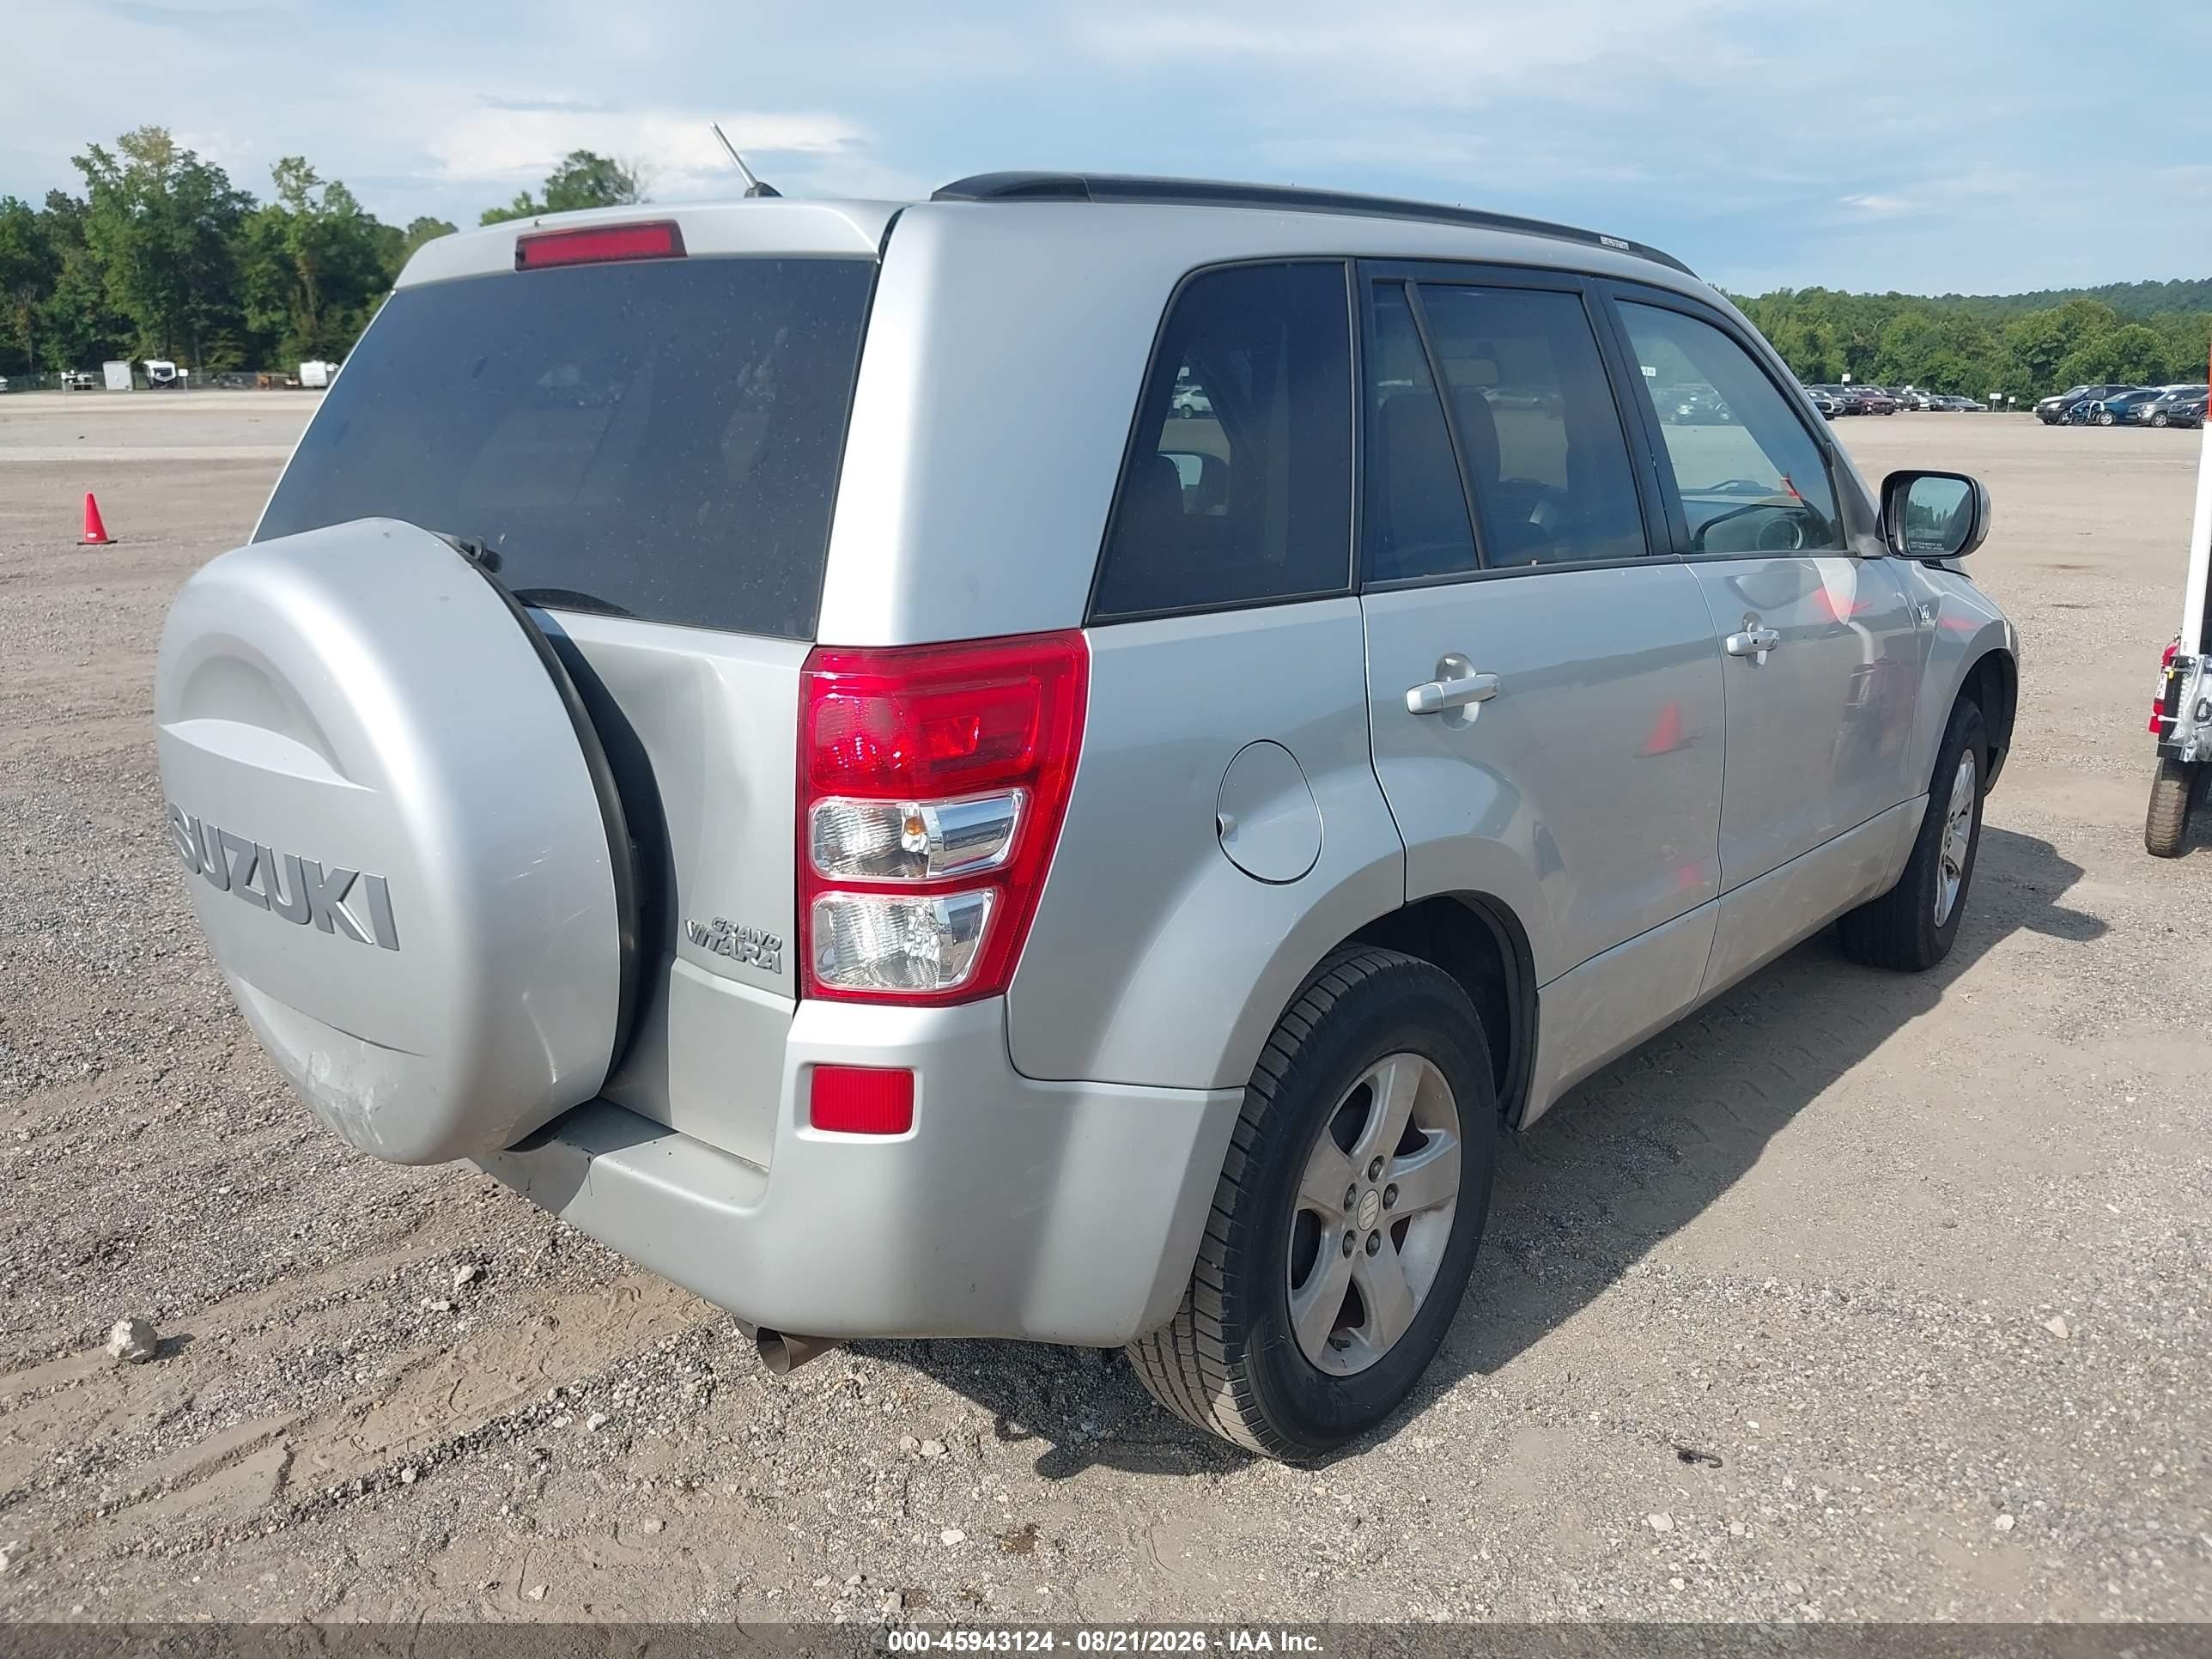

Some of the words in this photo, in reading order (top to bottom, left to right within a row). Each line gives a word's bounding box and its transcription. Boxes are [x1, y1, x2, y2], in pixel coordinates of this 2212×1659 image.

[169, 802, 400, 951] SUZUKI
[684, 919, 782, 974] VITARA
[711, 916, 782, 951] GRAND
